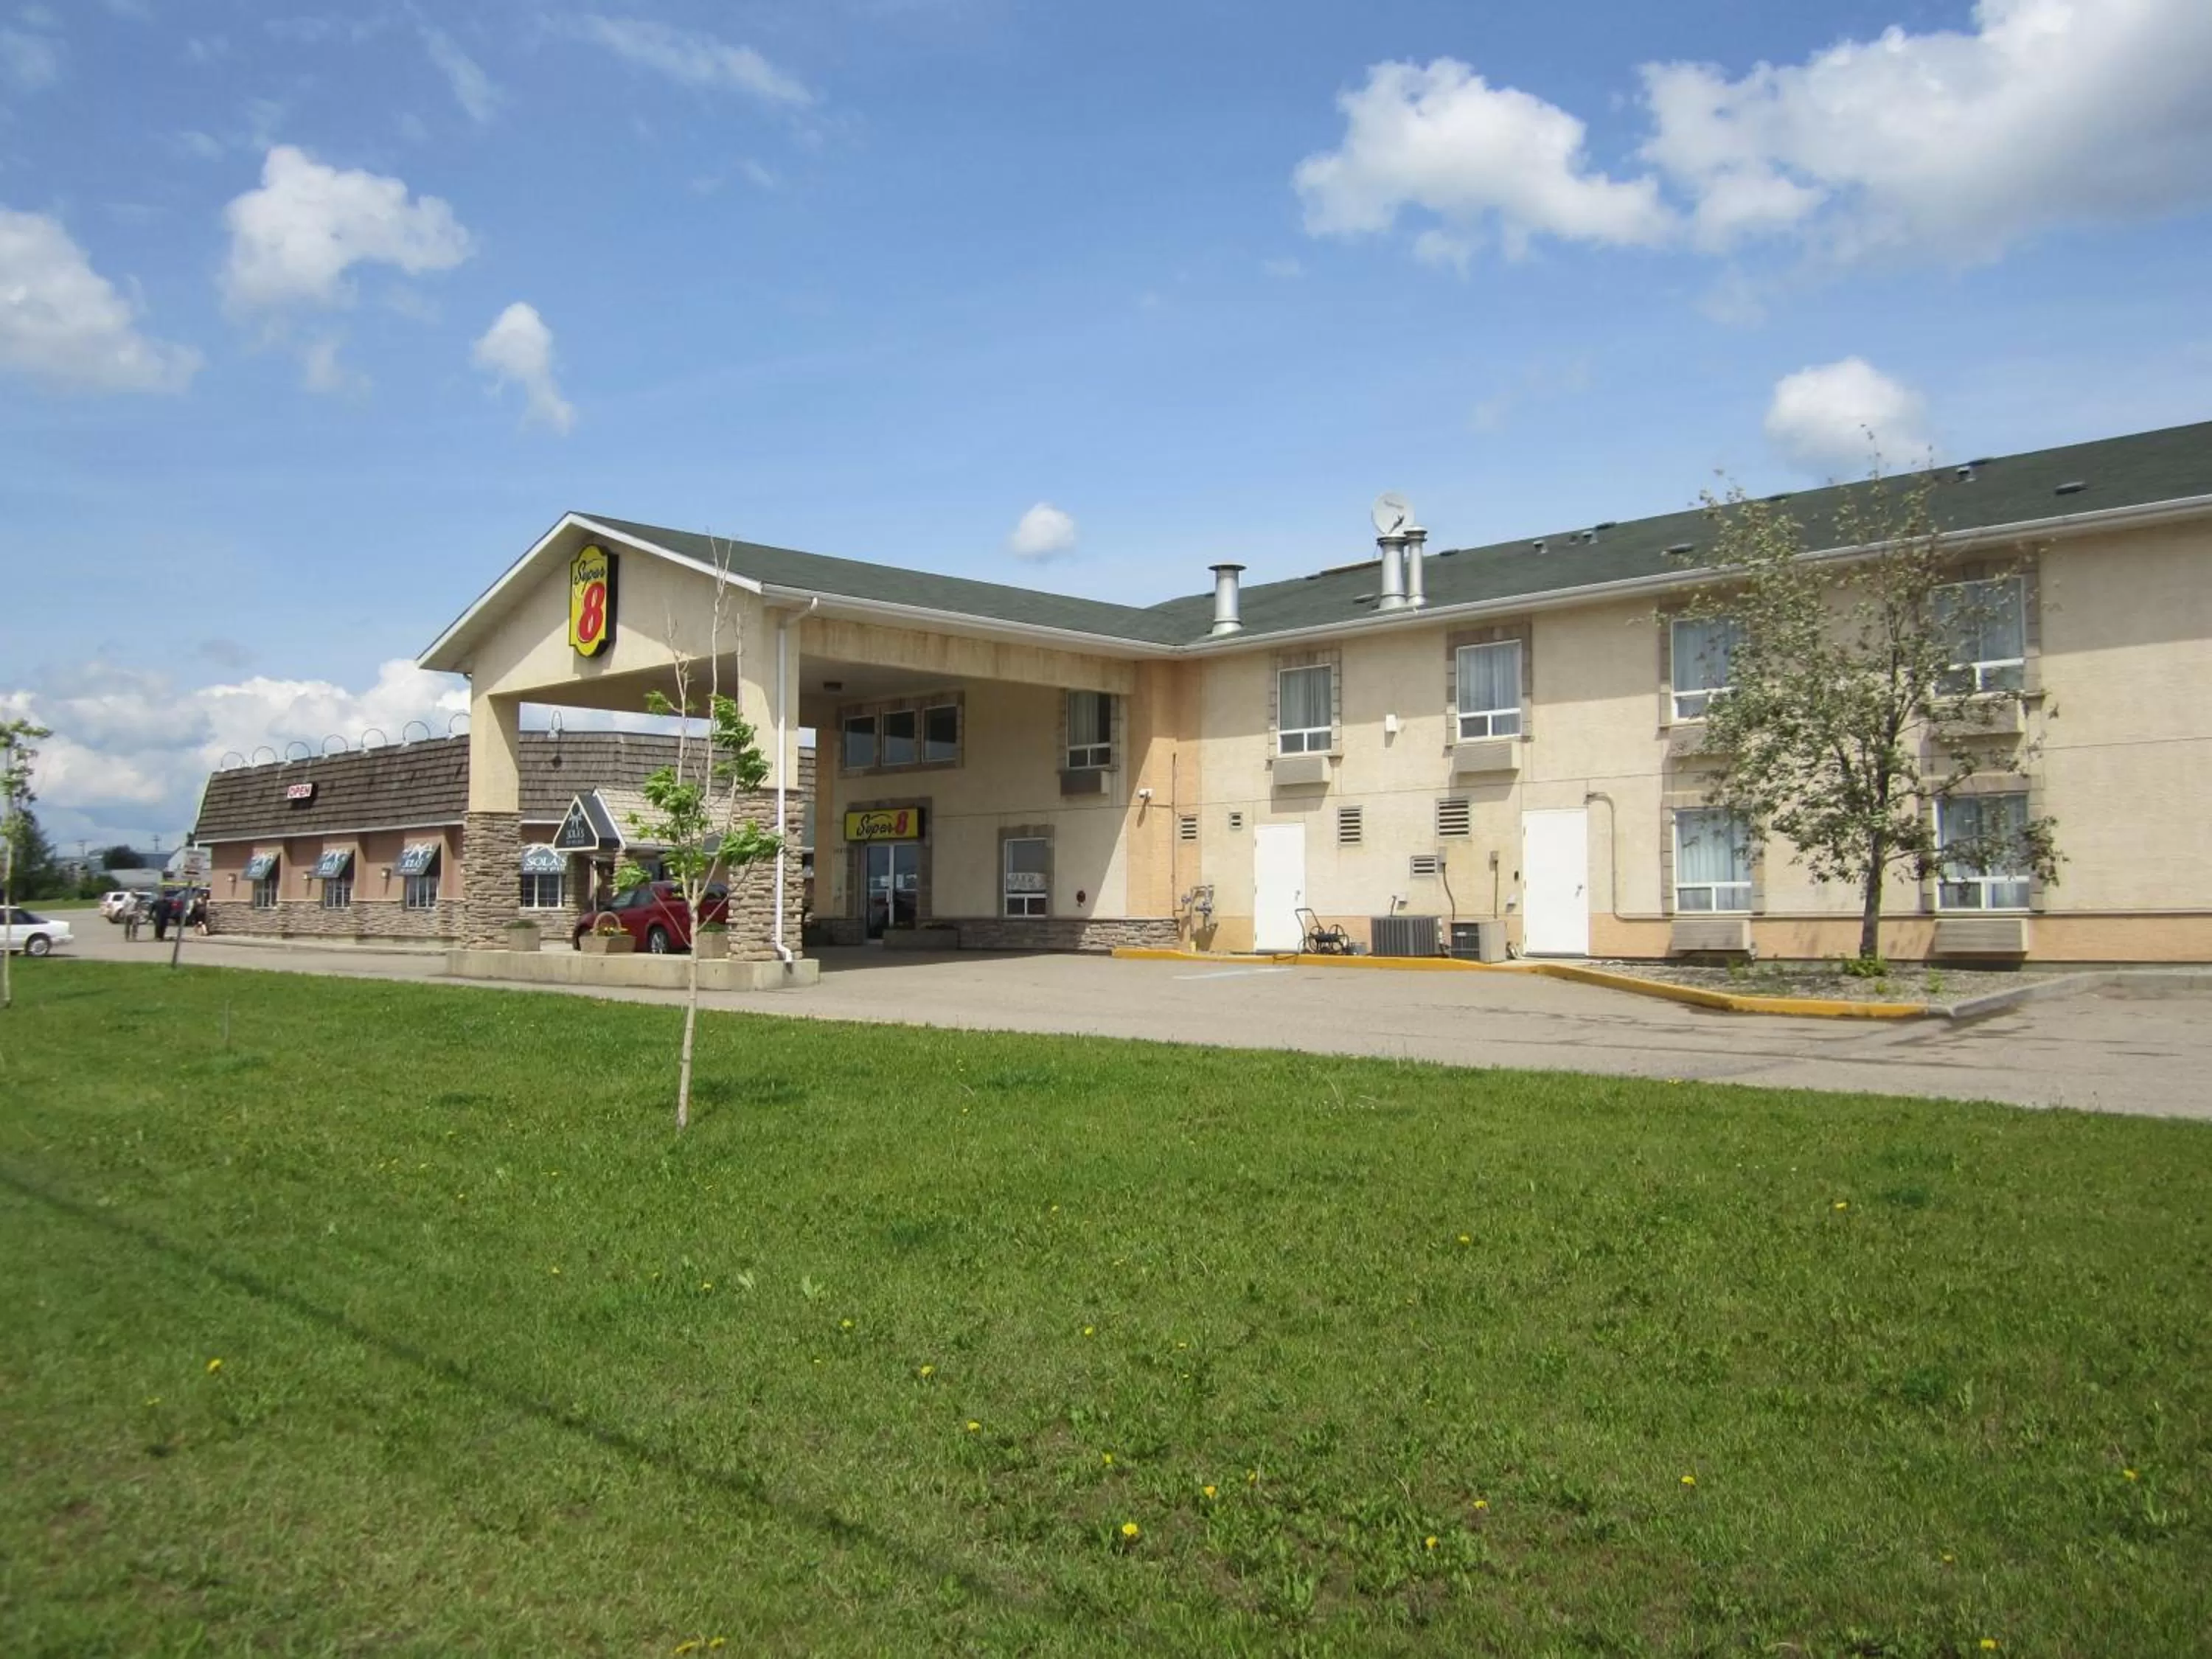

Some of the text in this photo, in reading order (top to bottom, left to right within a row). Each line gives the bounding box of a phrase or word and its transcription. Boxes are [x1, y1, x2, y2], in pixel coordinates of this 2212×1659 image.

[574, 558, 605, 594] Super
[578, 582, 605, 643] 8
[289, 785, 310, 797] OPEN
[856, 811, 908, 838] Super 8
